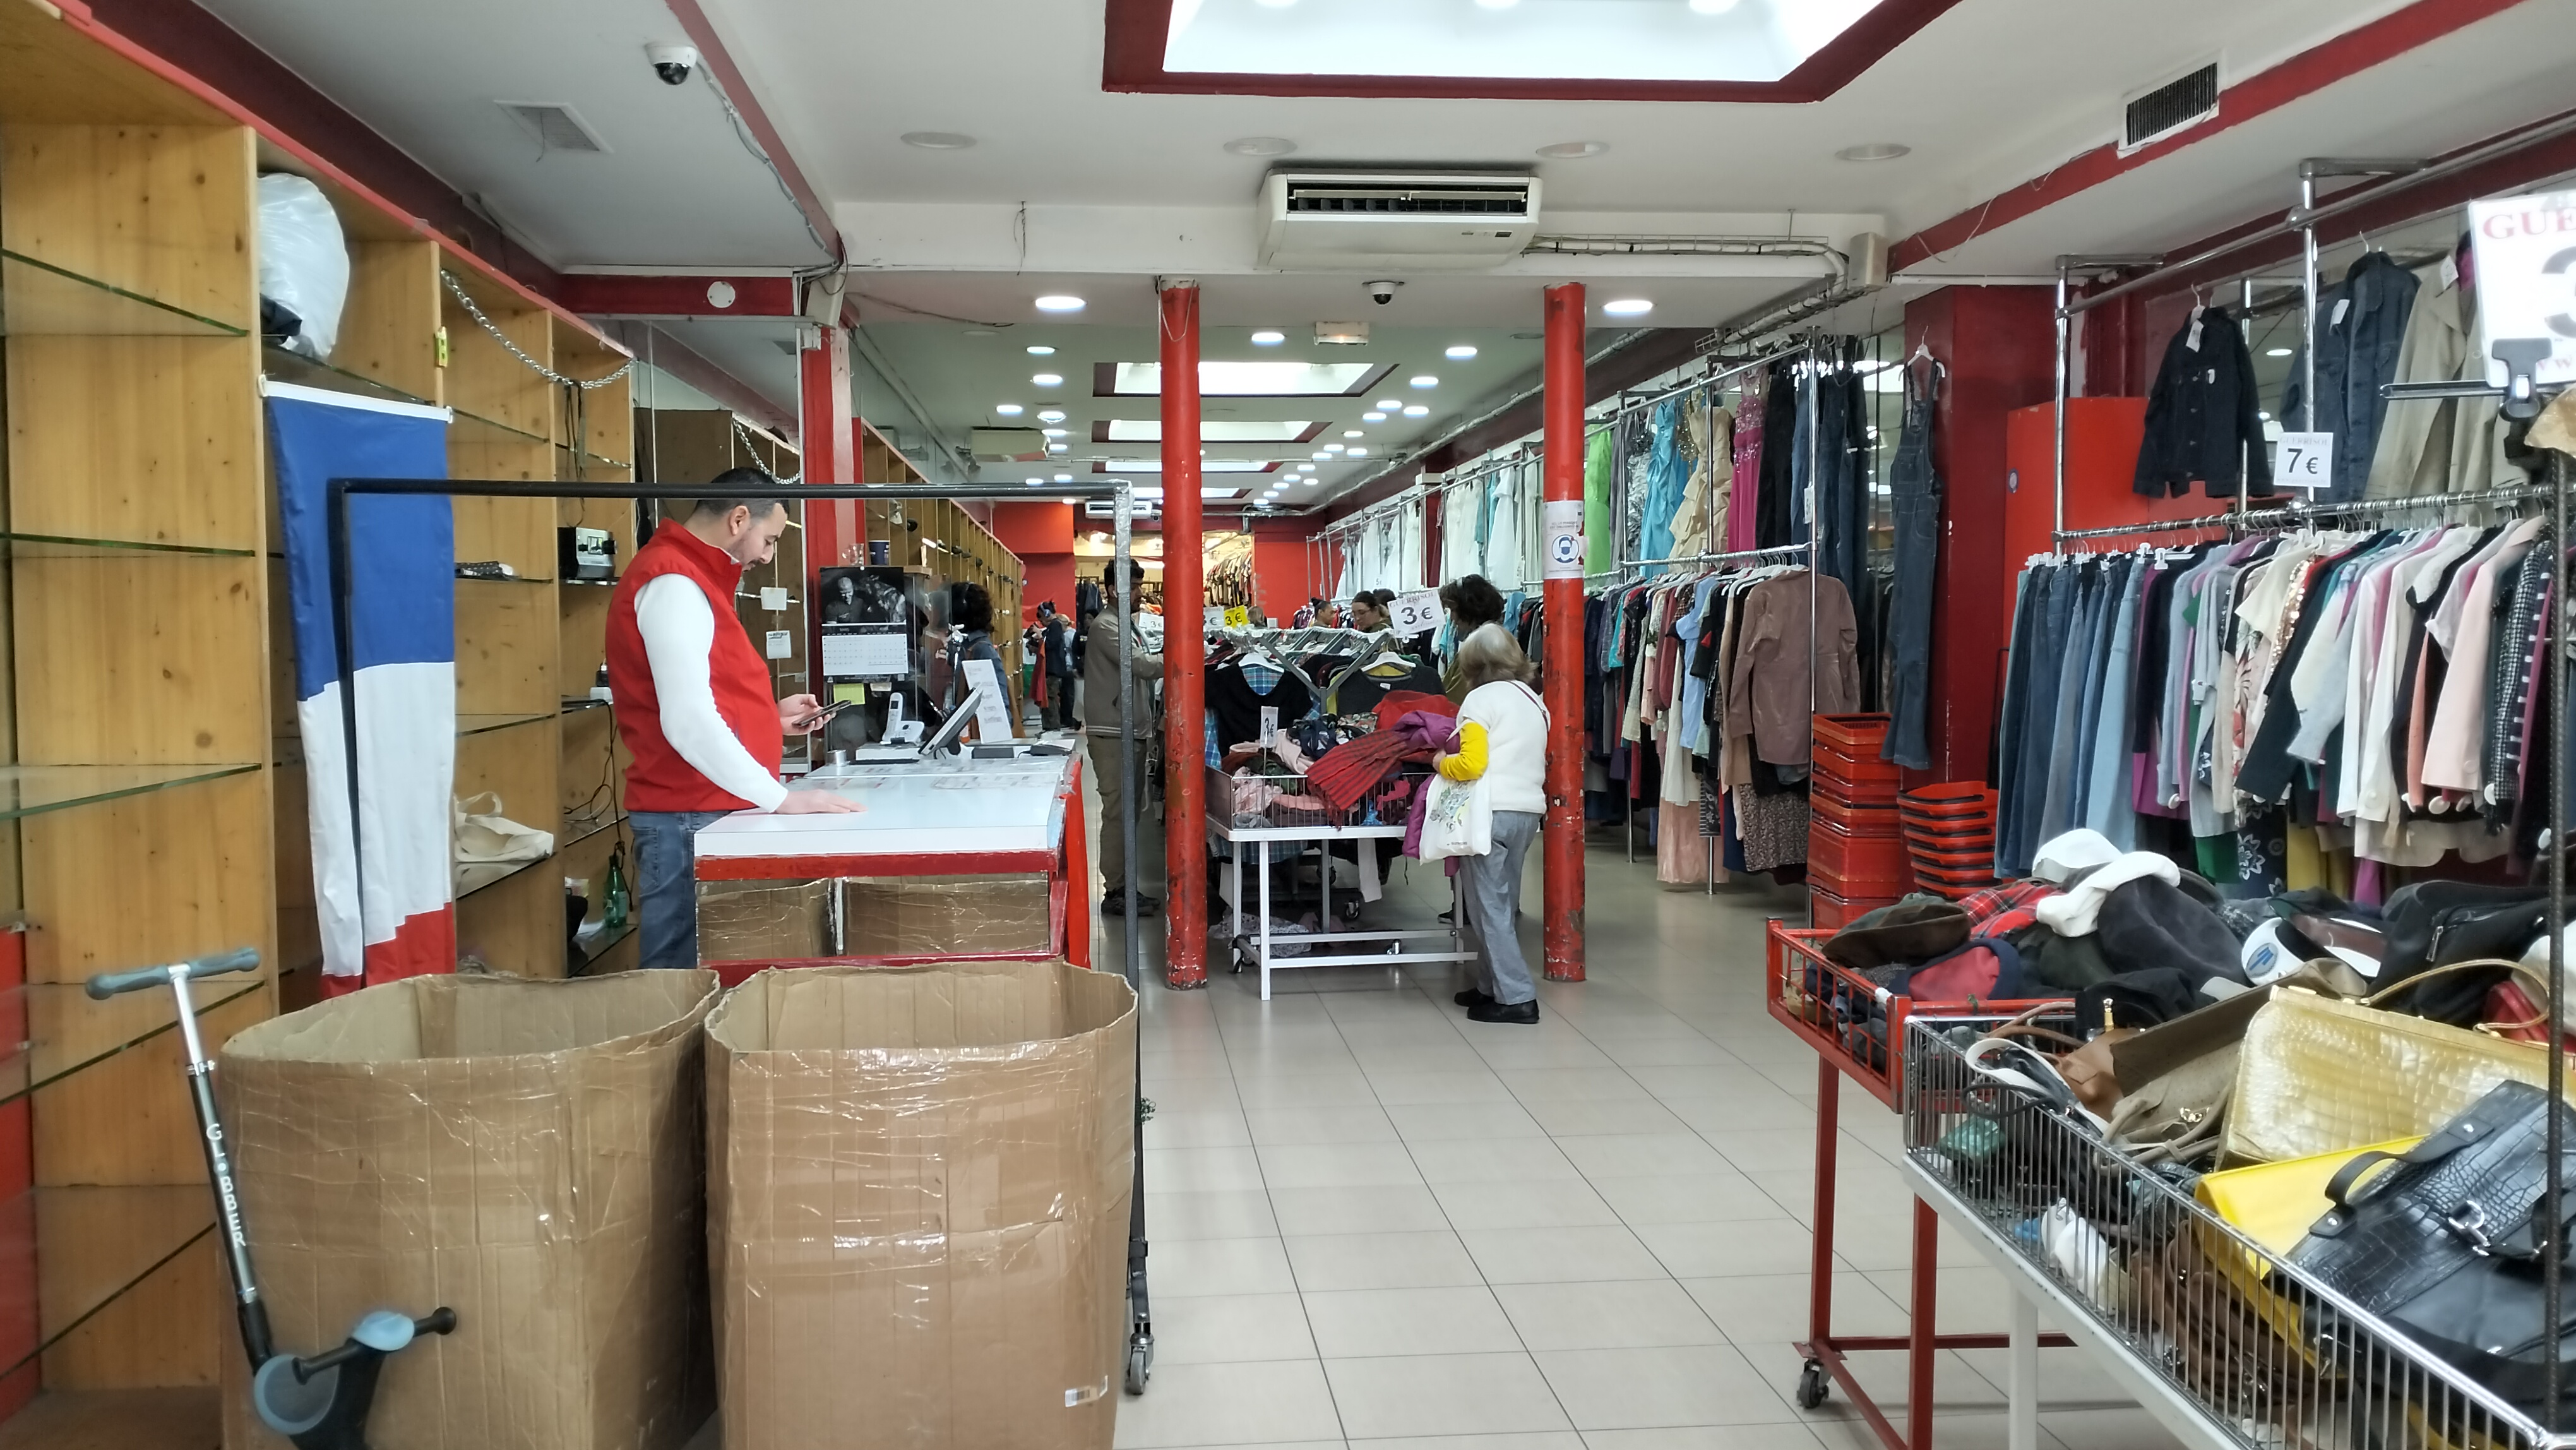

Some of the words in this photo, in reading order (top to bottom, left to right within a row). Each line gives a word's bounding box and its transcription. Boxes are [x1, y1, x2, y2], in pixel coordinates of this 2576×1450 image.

[2287, 448, 2303, 473] 7
[2306, 457, 2318, 474] €
[1225, 616, 1232, 626] 3
[1400, 606, 1417, 625] 3
[1421, 606, 1433, 620] €
[206, 1123, 246, 1248] GLOBBER
